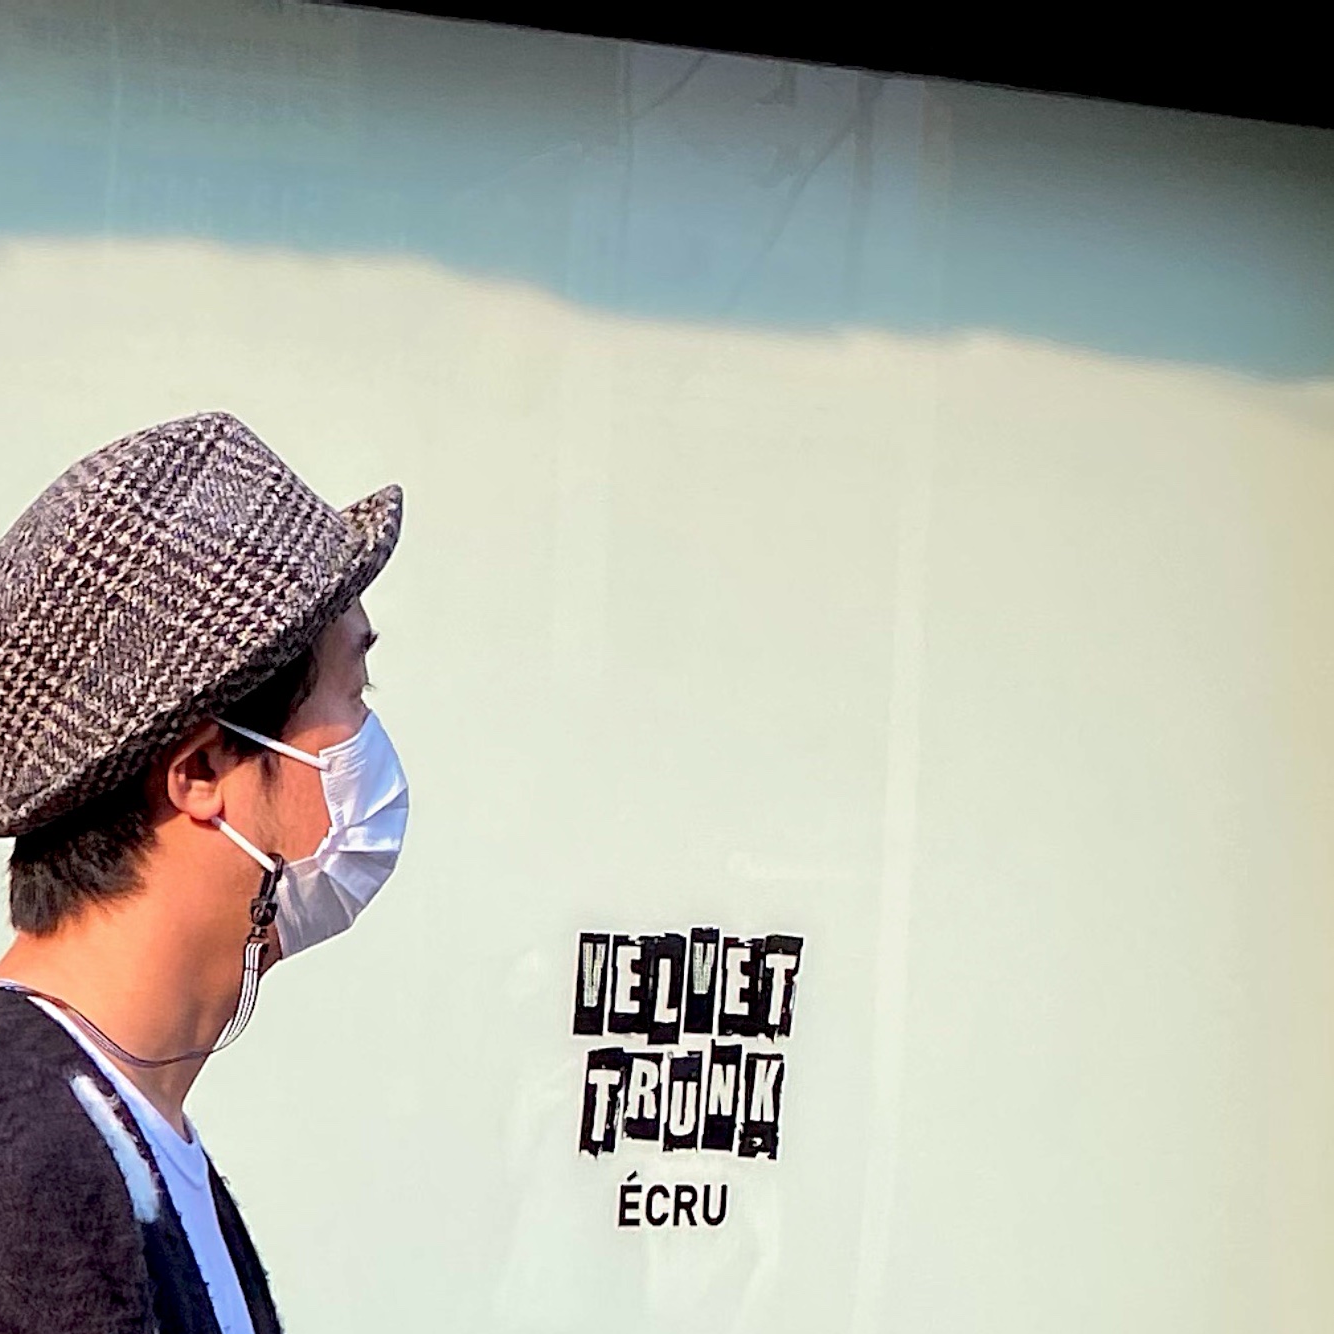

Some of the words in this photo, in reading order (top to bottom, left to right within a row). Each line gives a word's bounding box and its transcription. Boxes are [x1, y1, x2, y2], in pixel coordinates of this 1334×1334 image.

[576, 932, 801, 1040] VELVET
[582, 1046, 783, 1154] TRUNK
[618, 1171, 728, 1227] ÉCRU
